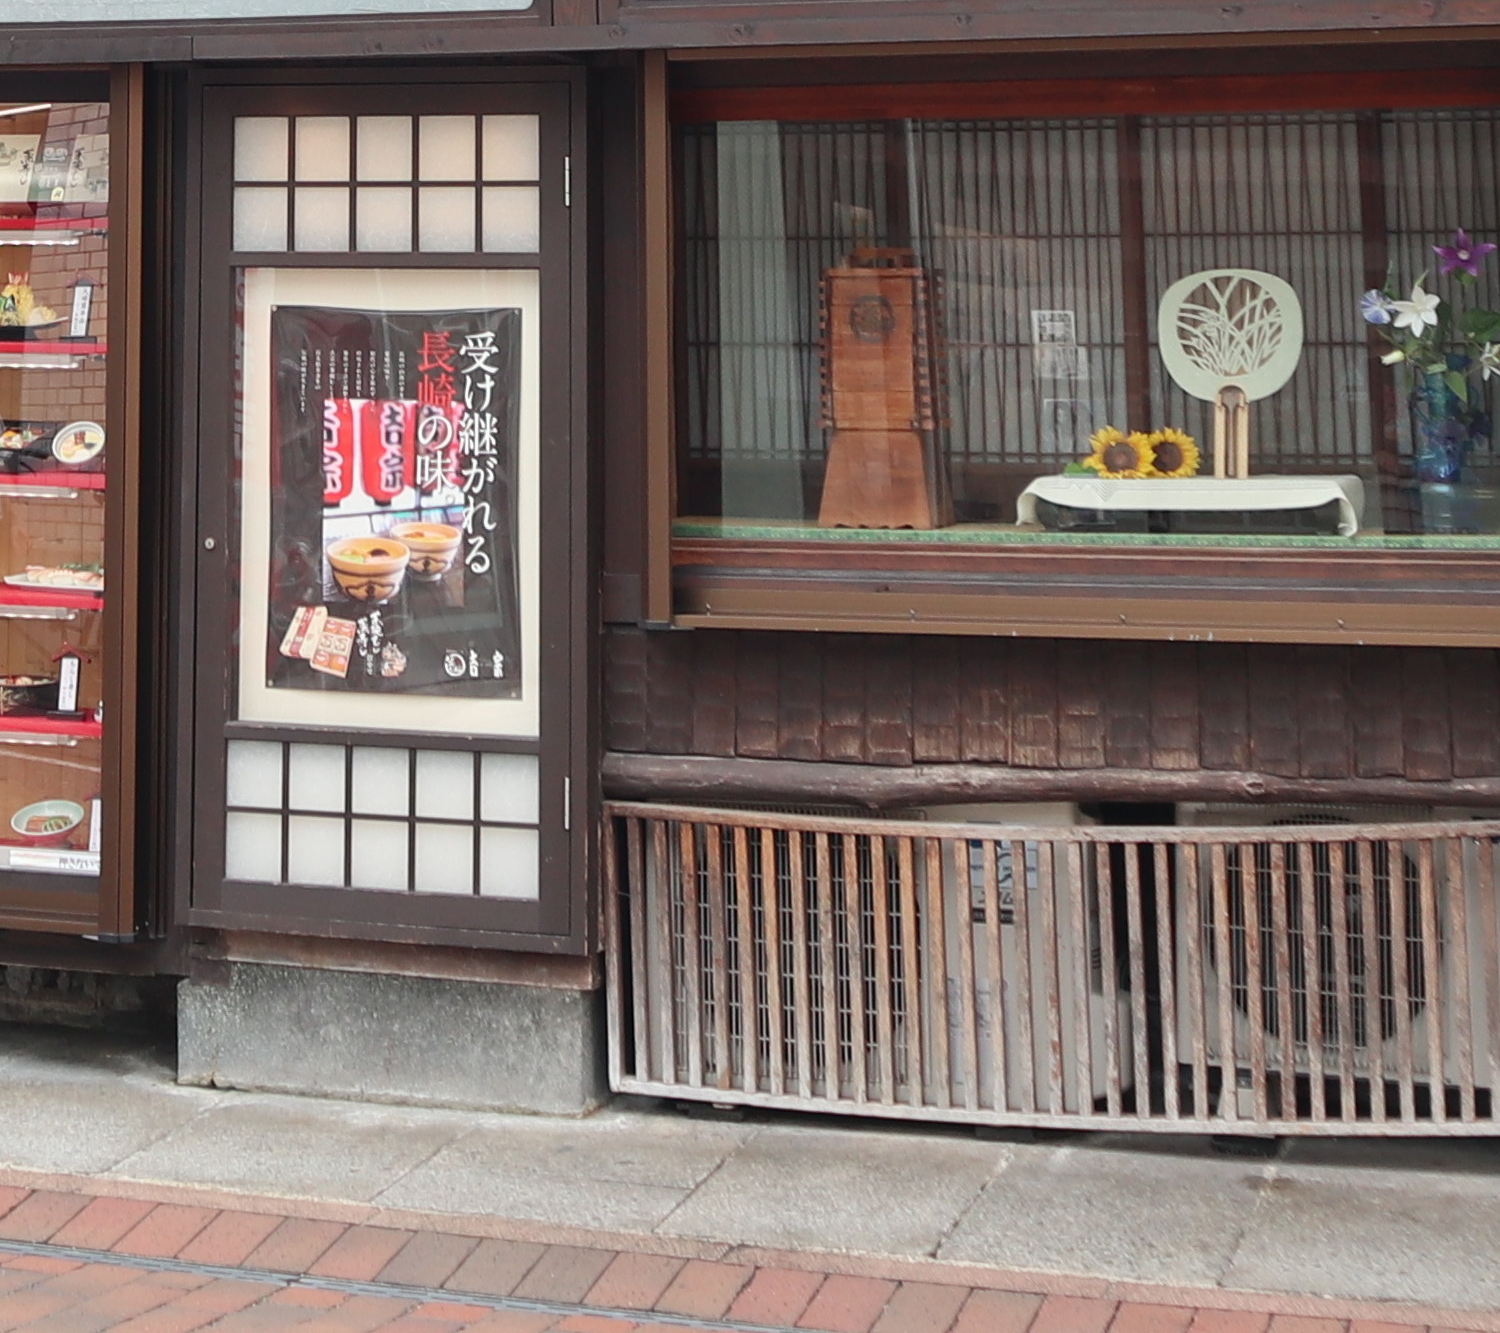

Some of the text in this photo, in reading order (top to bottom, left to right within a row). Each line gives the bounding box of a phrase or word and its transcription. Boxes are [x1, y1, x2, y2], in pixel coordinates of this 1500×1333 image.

[459, 331, 500, 574] 受け継がれる
